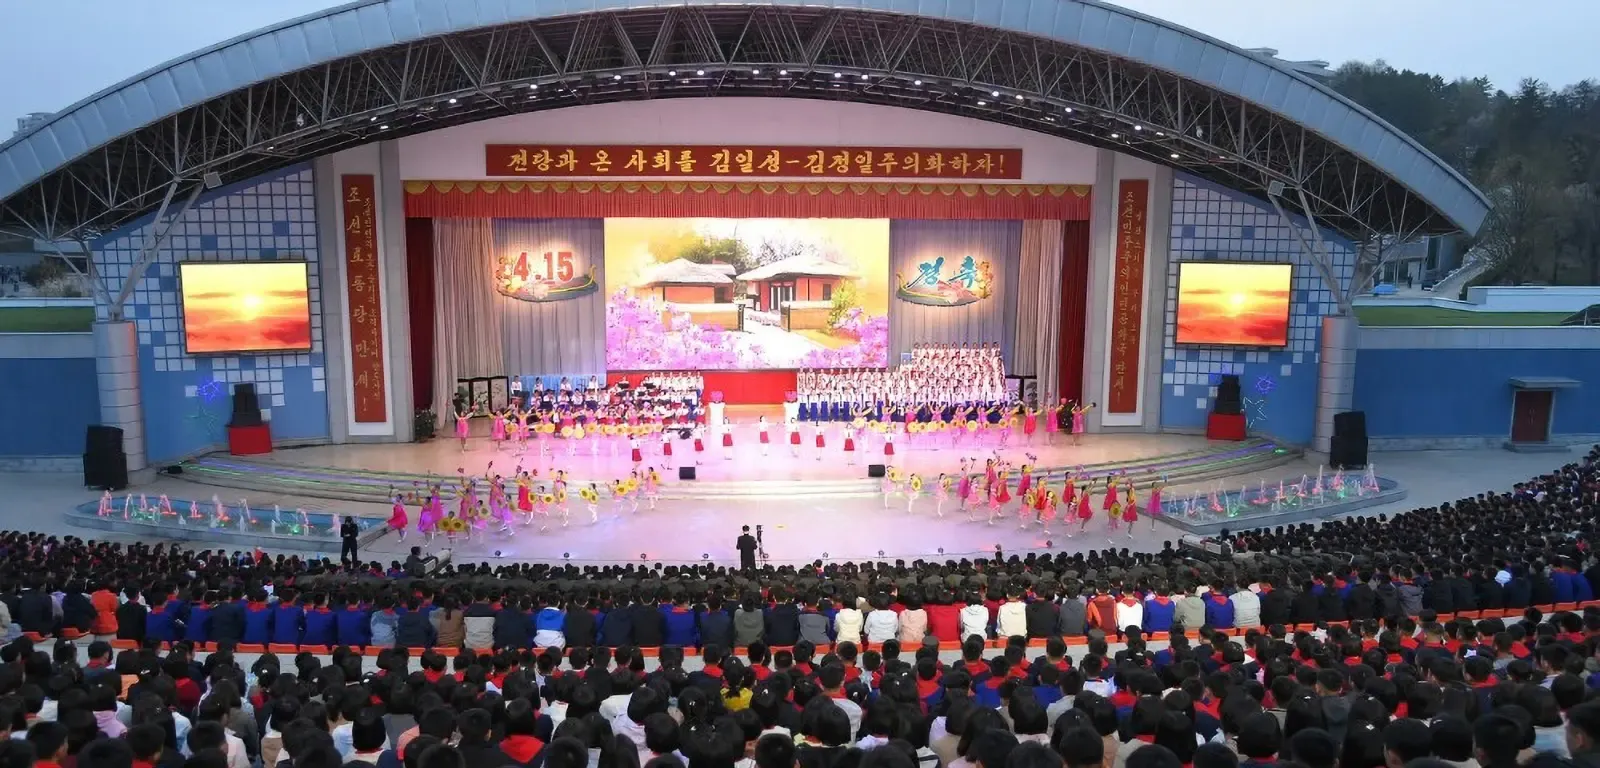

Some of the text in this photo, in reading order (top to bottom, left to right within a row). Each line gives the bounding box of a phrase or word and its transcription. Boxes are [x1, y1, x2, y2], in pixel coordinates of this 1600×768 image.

[506, 148, 1005, 176] 전당과 온 사회를 김일성-김정일주의화하자!
[347, 186, 368, 323] 조선로동당
[513, 251, 574, 282] 4.15
